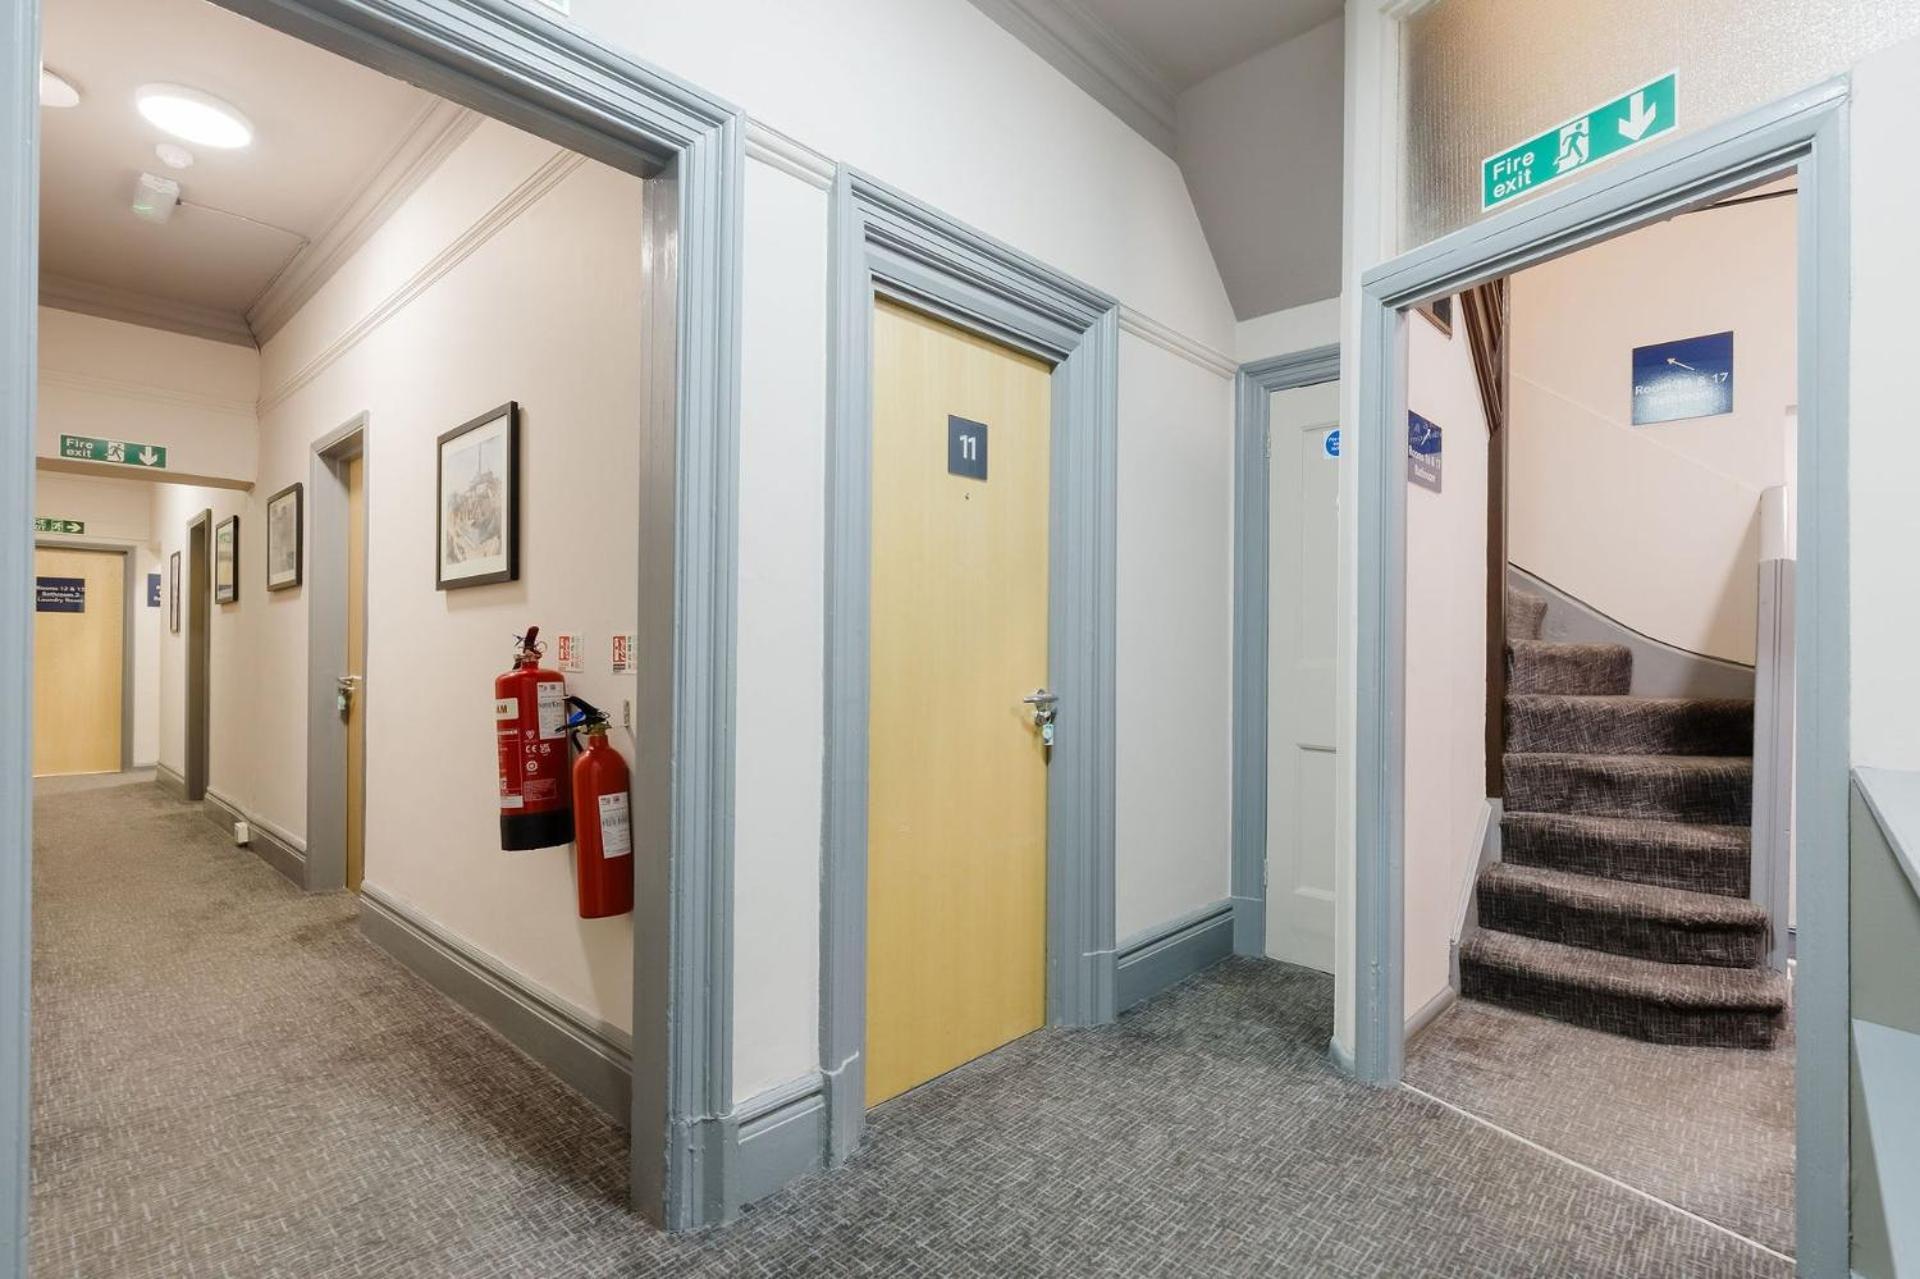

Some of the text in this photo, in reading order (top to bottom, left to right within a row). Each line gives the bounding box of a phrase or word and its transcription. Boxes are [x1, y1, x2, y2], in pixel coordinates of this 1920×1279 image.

[1493, 151, 1535, 181] Fire
[1493, 168, 1532, 198] exit
[1712, 371, 1729, 384] 17
[66, 438, 93, 450] Fire
[66, 449, 92, 459] exit
[959, 434, 977, 461] 11
